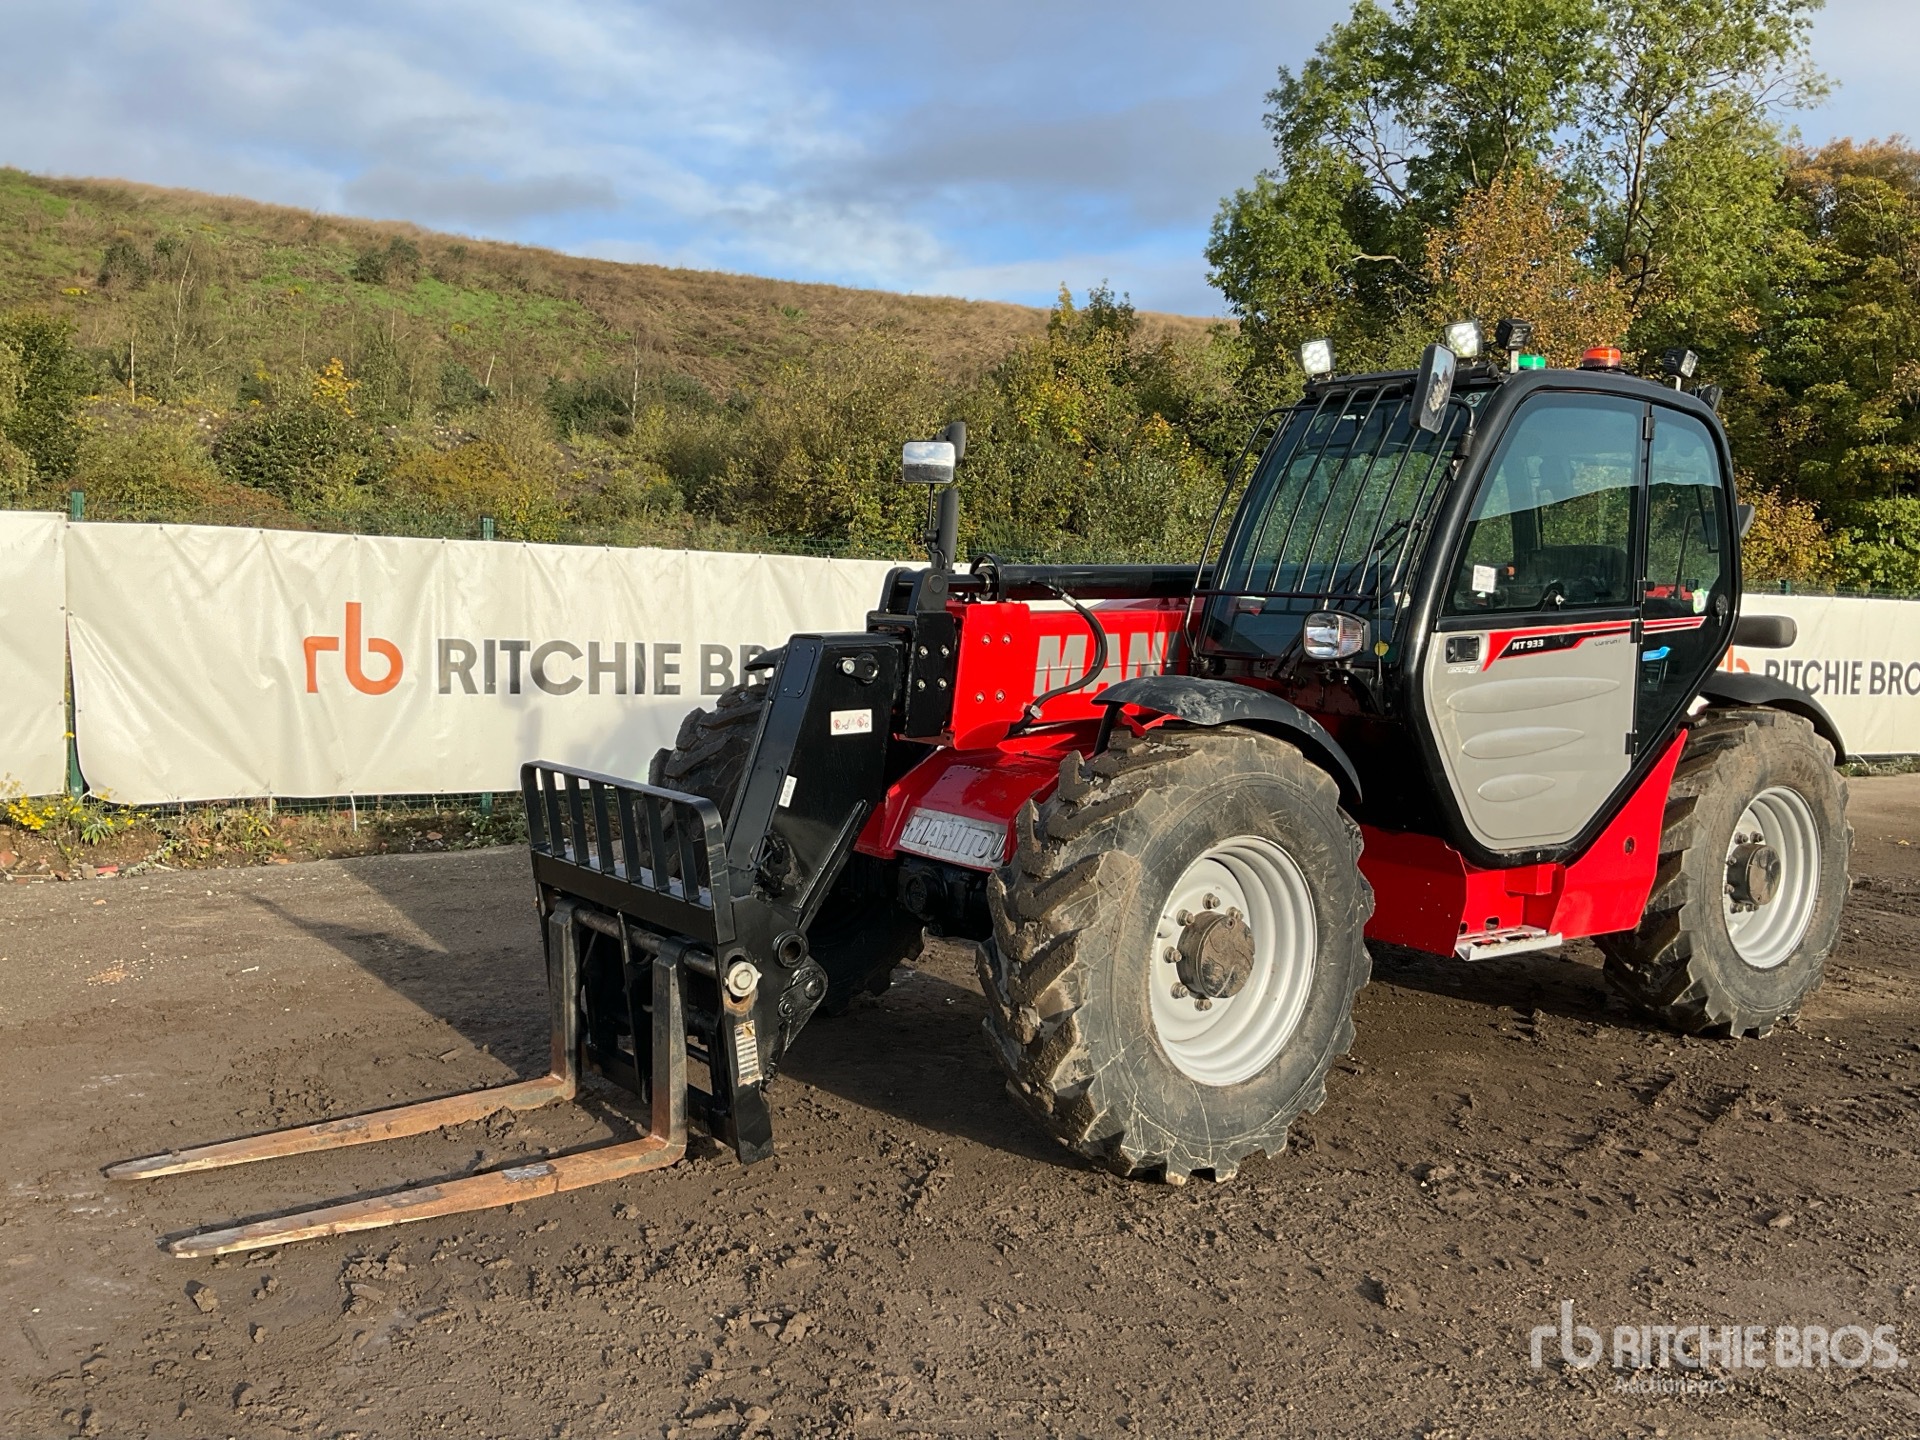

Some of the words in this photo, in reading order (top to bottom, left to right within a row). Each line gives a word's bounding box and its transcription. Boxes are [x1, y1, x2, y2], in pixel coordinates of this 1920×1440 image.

[303, 602, 404, 695] rb
[437, 638, 682, 696] RITCHIE
[1526, 639, 1544, 649] 933
[902, 814, 1007, 862] MANITOU
